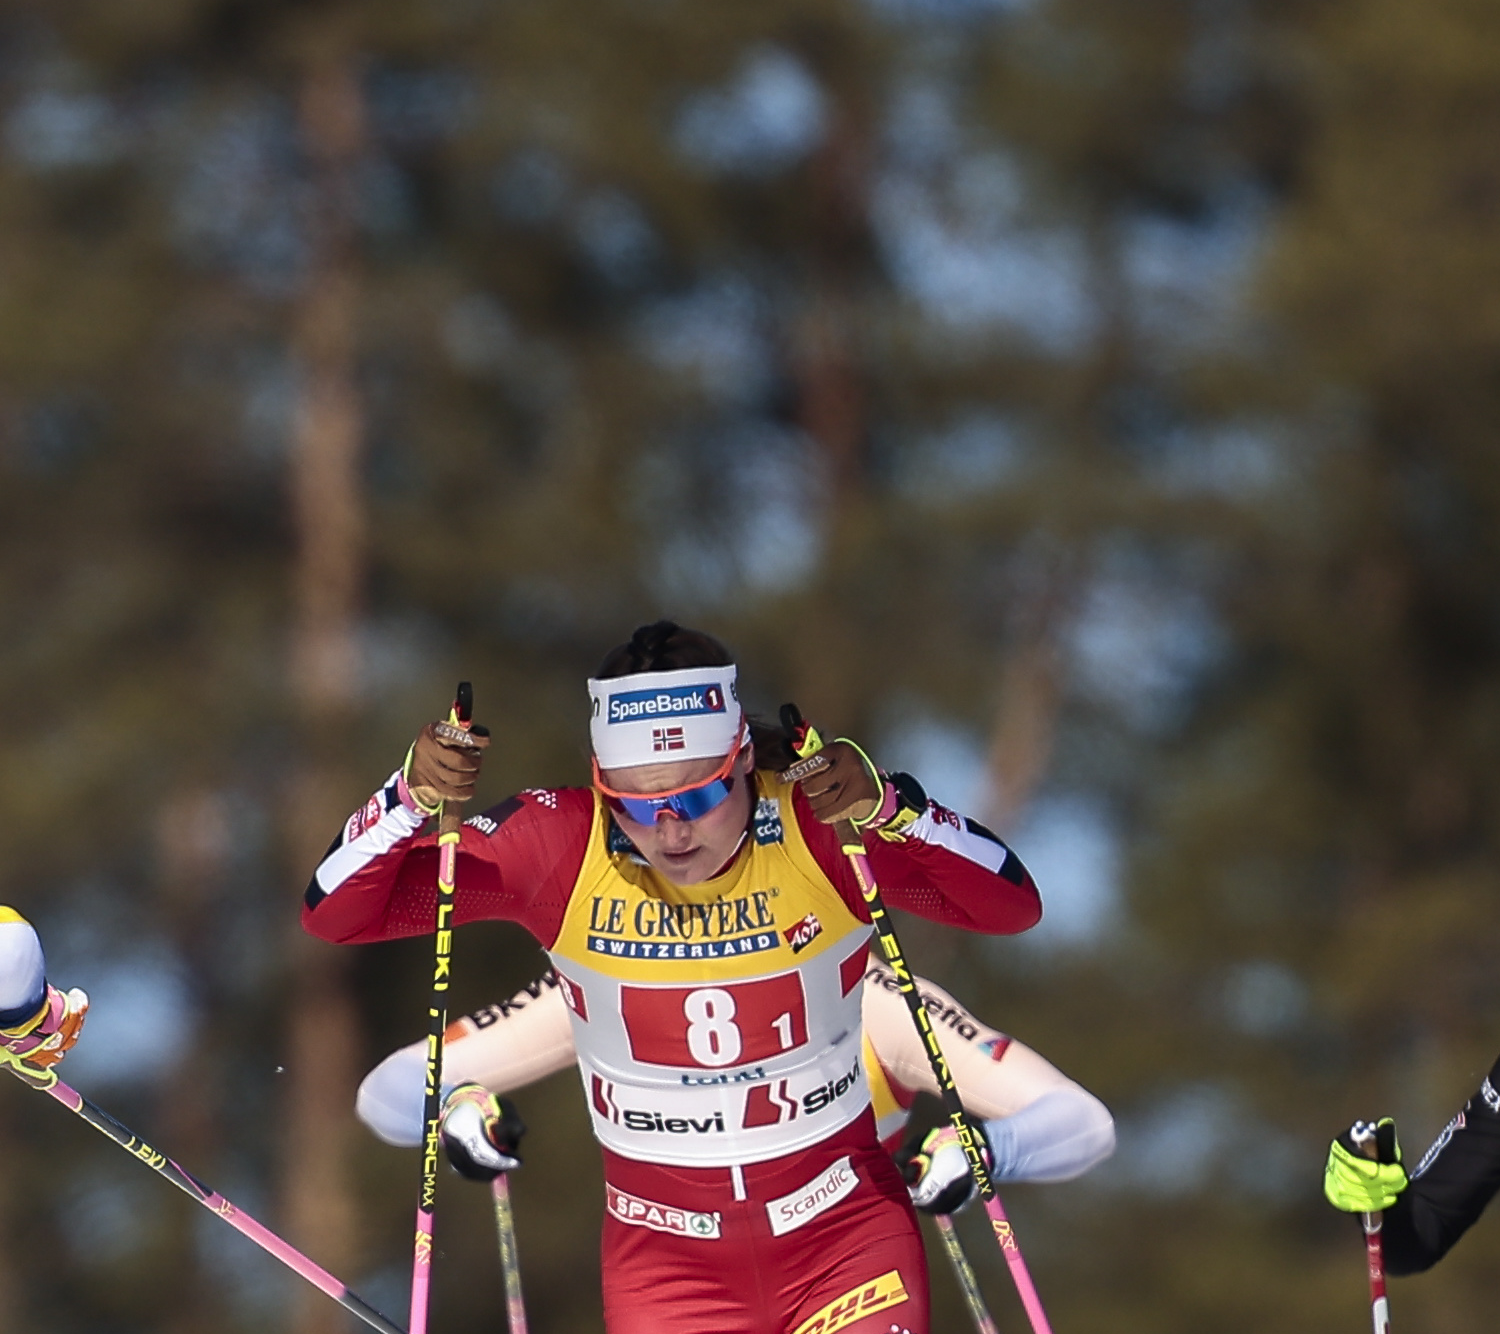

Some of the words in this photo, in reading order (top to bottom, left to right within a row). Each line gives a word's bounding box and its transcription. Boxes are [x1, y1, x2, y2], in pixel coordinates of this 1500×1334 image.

[610, 690, 704, 721] SpareBank
[708, 689, 719, 707] 1
[782, 753, 827, 782] HESTRA
[589, 896, 626, 934] LE
[634, 890, 775, 942] GRUYÈRE
[434, 903, 454, 992] LEKI
[594, 935, 770, 958] SWITZERLAND
[870, 909, 915, 993] LEKI
[684, 987, 742, 1067] 8
[771, 1012, 795, 1050] 1
[802, 1056, 861, 1116] Sievi
[623, 1109, 726, 1134] Sievi
[615, 1195, 687, 1231] SPAR
[780, 1166, 849, 1223] Scandic
